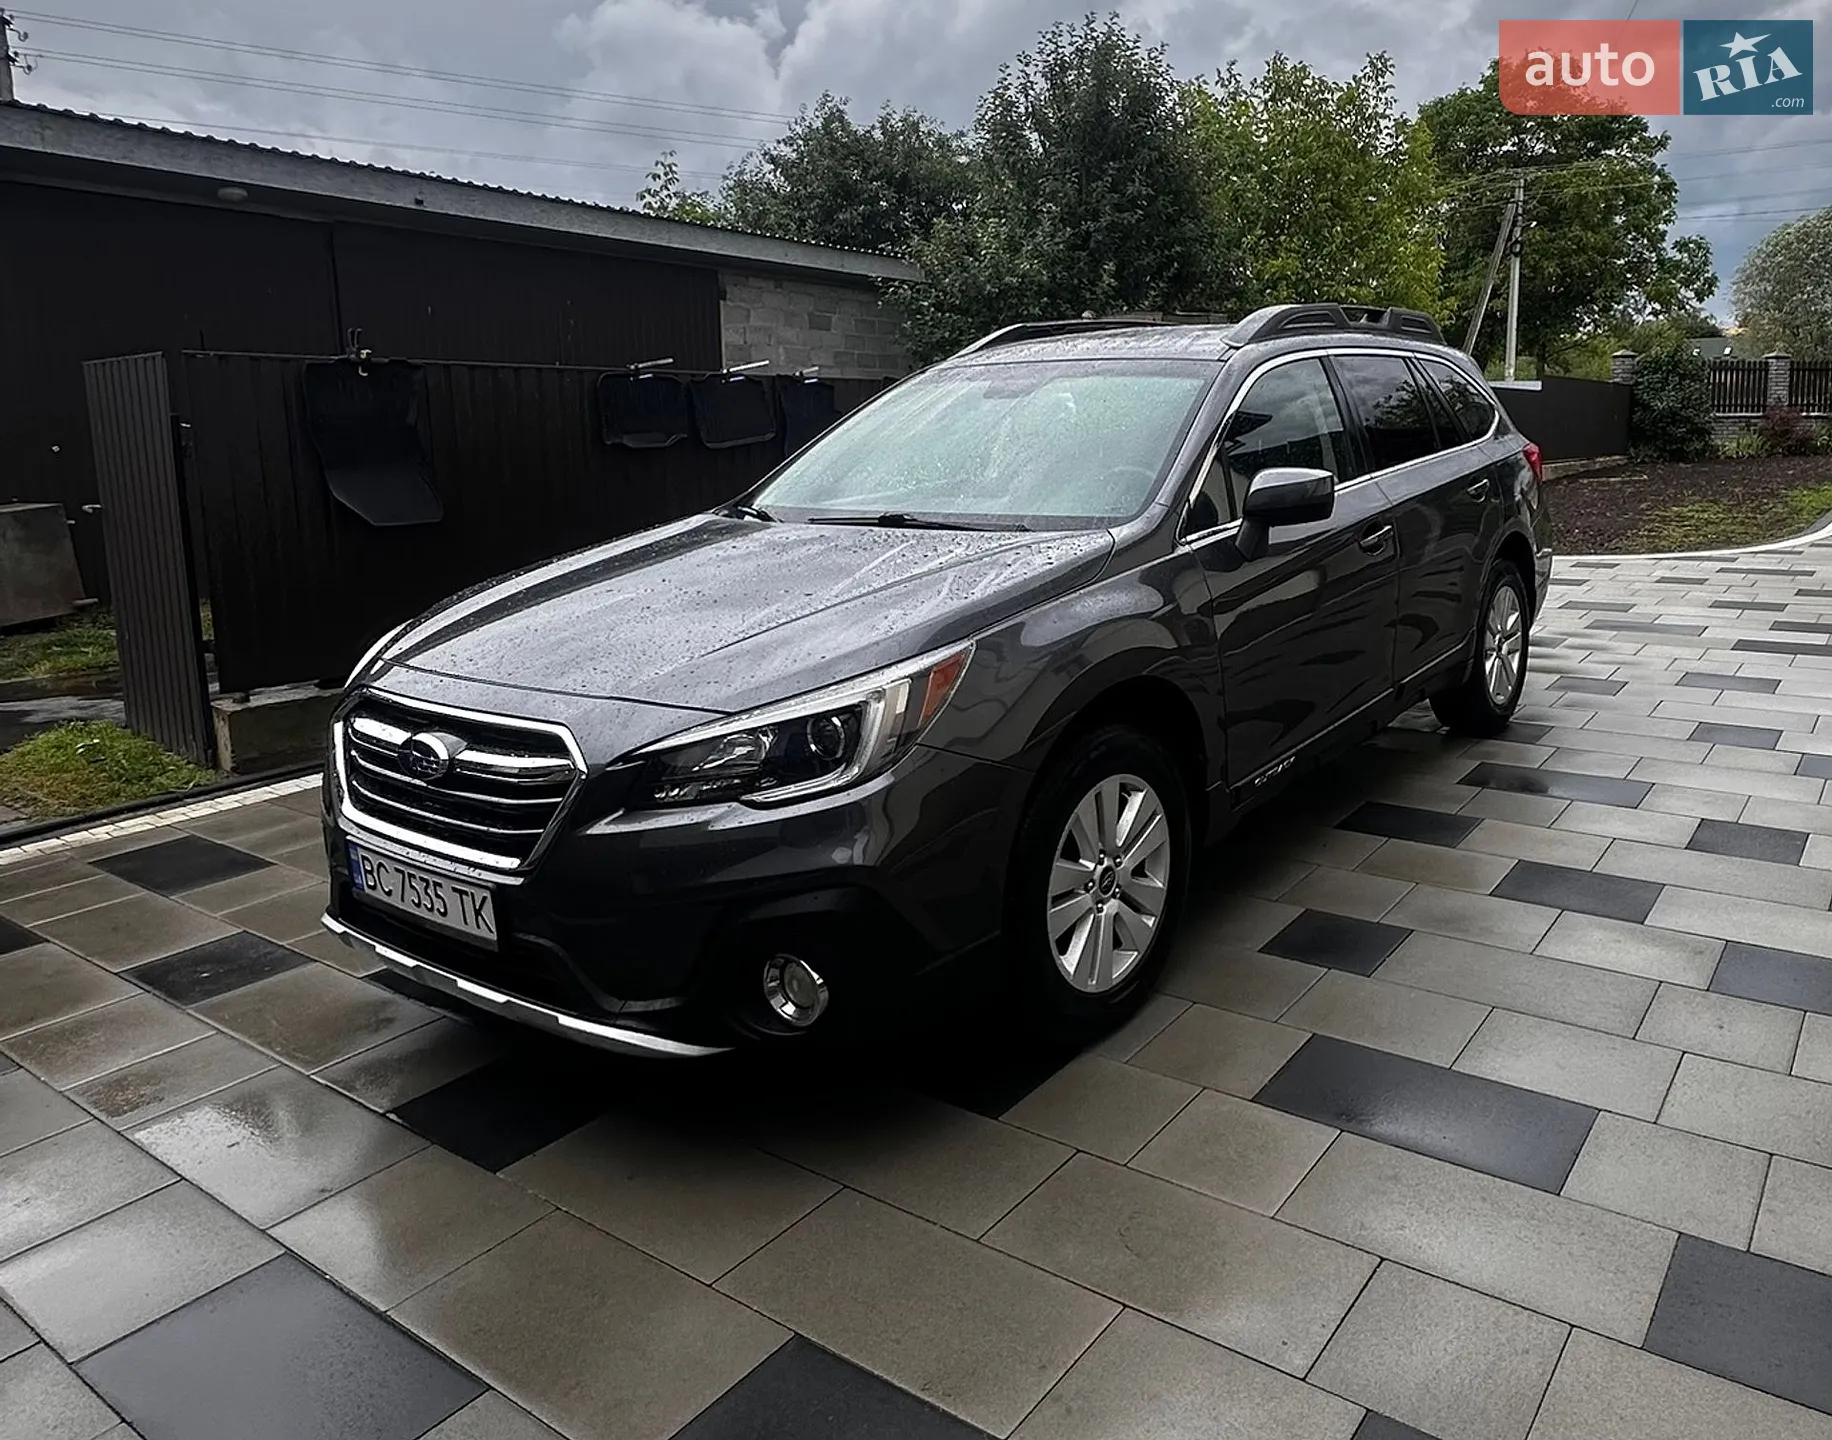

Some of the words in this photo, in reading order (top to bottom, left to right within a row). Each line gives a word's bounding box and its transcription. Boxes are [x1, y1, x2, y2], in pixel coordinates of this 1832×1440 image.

[361, 854, 393, 897] BC
[394, 866, 448, 918] 7535
[451, 886, 495, 934] TK
